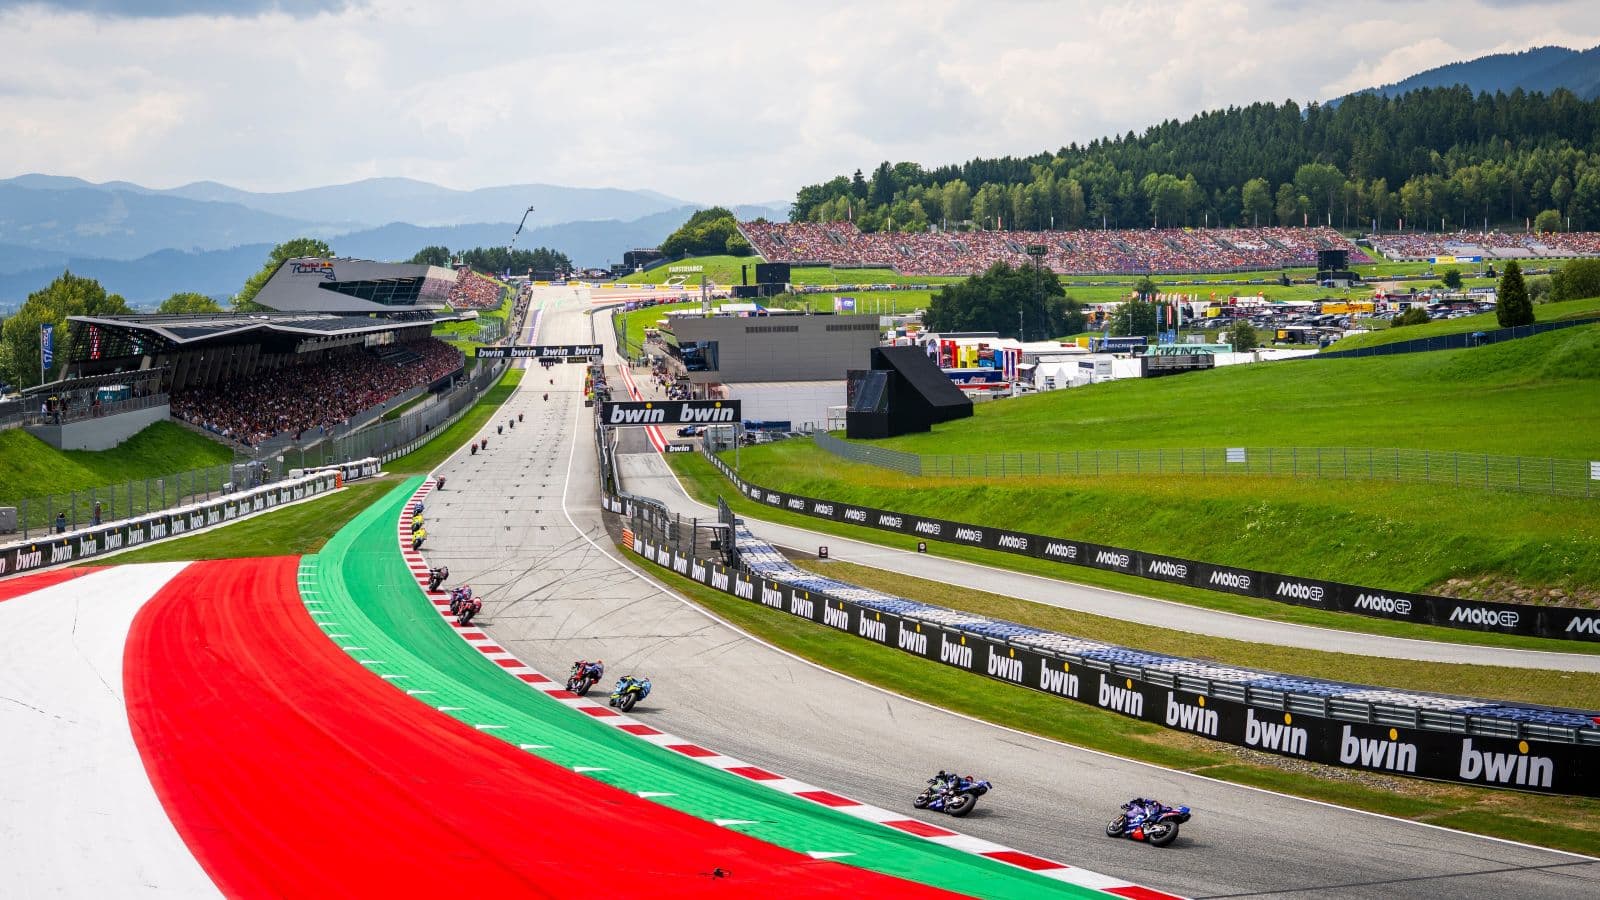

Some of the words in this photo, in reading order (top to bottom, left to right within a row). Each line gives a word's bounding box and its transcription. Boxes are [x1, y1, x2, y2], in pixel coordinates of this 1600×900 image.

[479, 347, 504, 357] bwin
[511, 346, 537, 357] bwin
[543, 345, 568, 356] bwin
[575, 344, 600, 355] bwin
[610, 402, 665, 423] bwin
[680, 401, 734, 421] bwin
[669, 444, 690, 452] bwin
[16, 544, 41, 570] bwin
[51, 538, 72, 562] bwin
[80, 533, 96, 556] bwin
[105, 528, 122, 550] bwin
[128, 521, 144, 545] bwin
[151, 517, 166, 539] bwin
[916, 521, 941, 535] MotoGP
[955, 528, 982, 542] MotoGP
[999, 534, 1027, 550] MotoGP
[1045, 542, 1077, 559] MotoGP
[1096, 551, 1129, 568] MotoGP
[1149, 560, 1187, 578] MotoGP
[1210, 571, 1250, 589] MotoGP
[1276, 581, 1324, 601] MotoGP
[1354, 593, 1412, 615] MotoGP
[1449, 606, 1519, 627] MotoGP
[712, 565, 728, 591] bwin
[735, 573, 753, 600] bwin
[762, 580, 782, 608] bwin
[791, 589, 813, 619] bwin
[824, 600, 848, 630] bwin
[859, 610, 886, 642] bwin
[899, 621, 927, 654] bwin
[940, 633, 972, 668] bwin
[987, 645, 1022, 682] bwin
[1040, 658, 1078, 698] bwin
[1099, 673, 1143, 717] bwin
[1166, 691, 1218, 736] bwin
[1245, 708, 1307, 756] bwin
[1340, 725, 1417, 773] bwin
[1459, 738, 1553, 788] bwin
